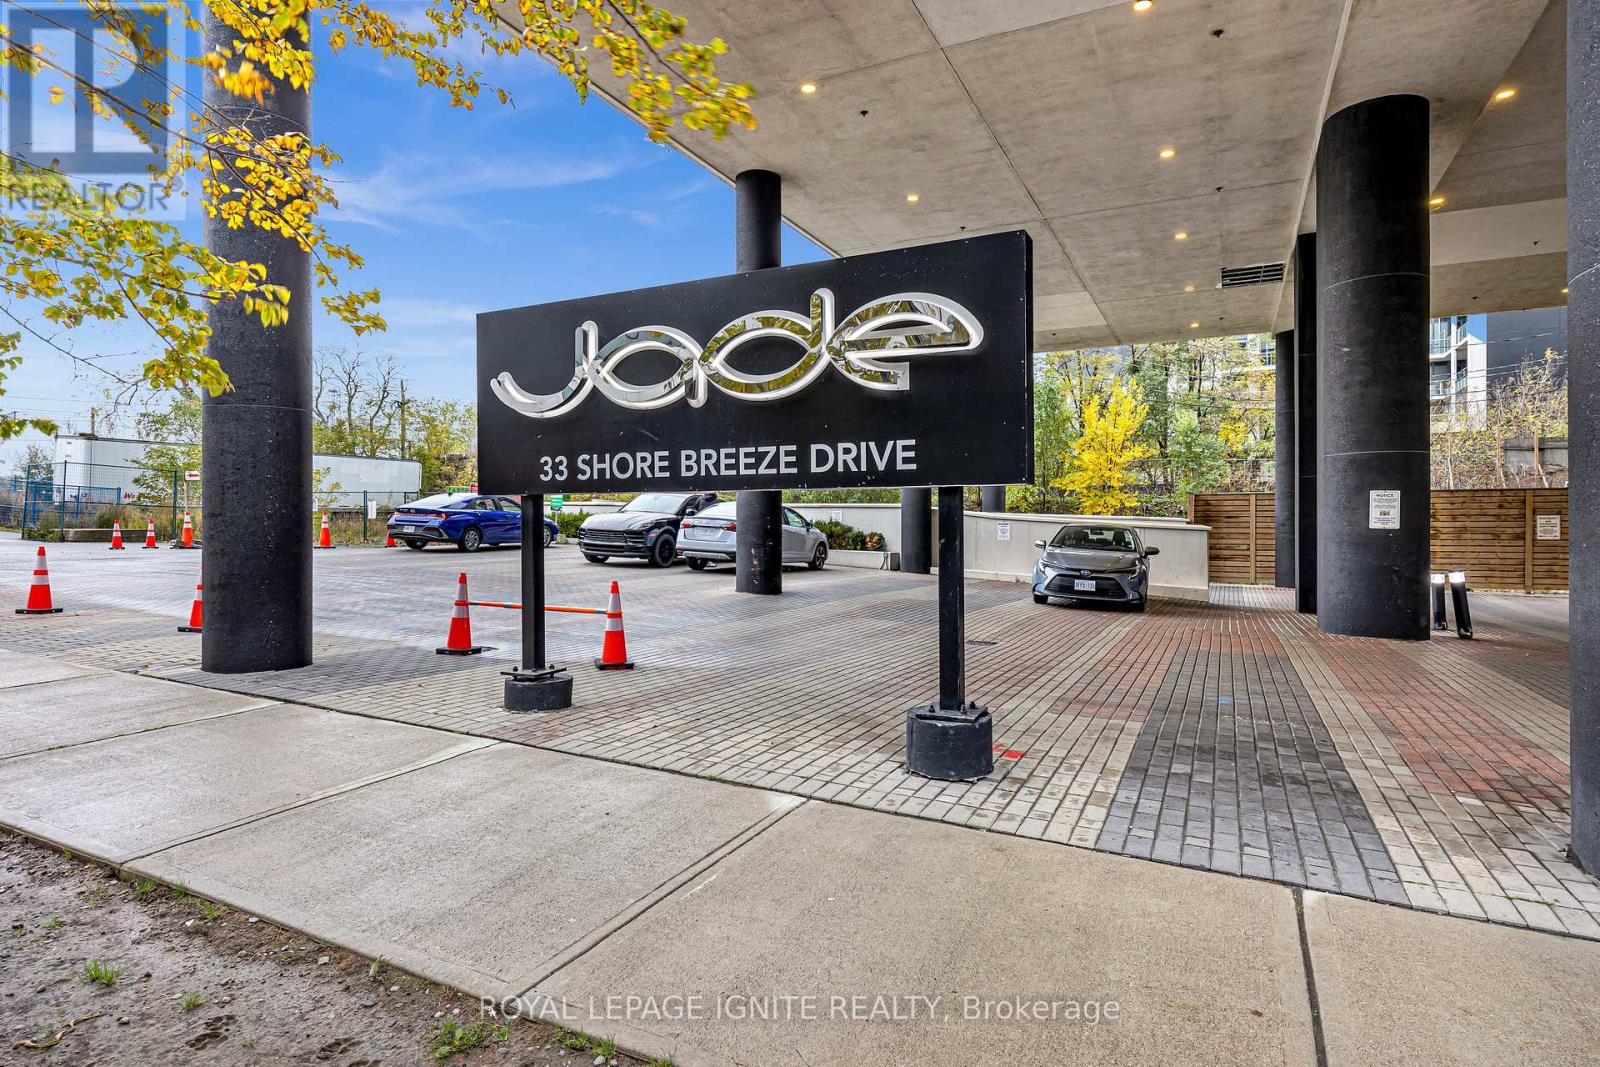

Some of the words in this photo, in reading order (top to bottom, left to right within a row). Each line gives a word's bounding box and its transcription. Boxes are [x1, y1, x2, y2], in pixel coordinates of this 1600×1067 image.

[539, 455, 568, 481] 33
[576, 449, 669, 480] SHORE
[680, 444, 798, 476] BREEZE
[810, 439, 917, 474] DRIVE
